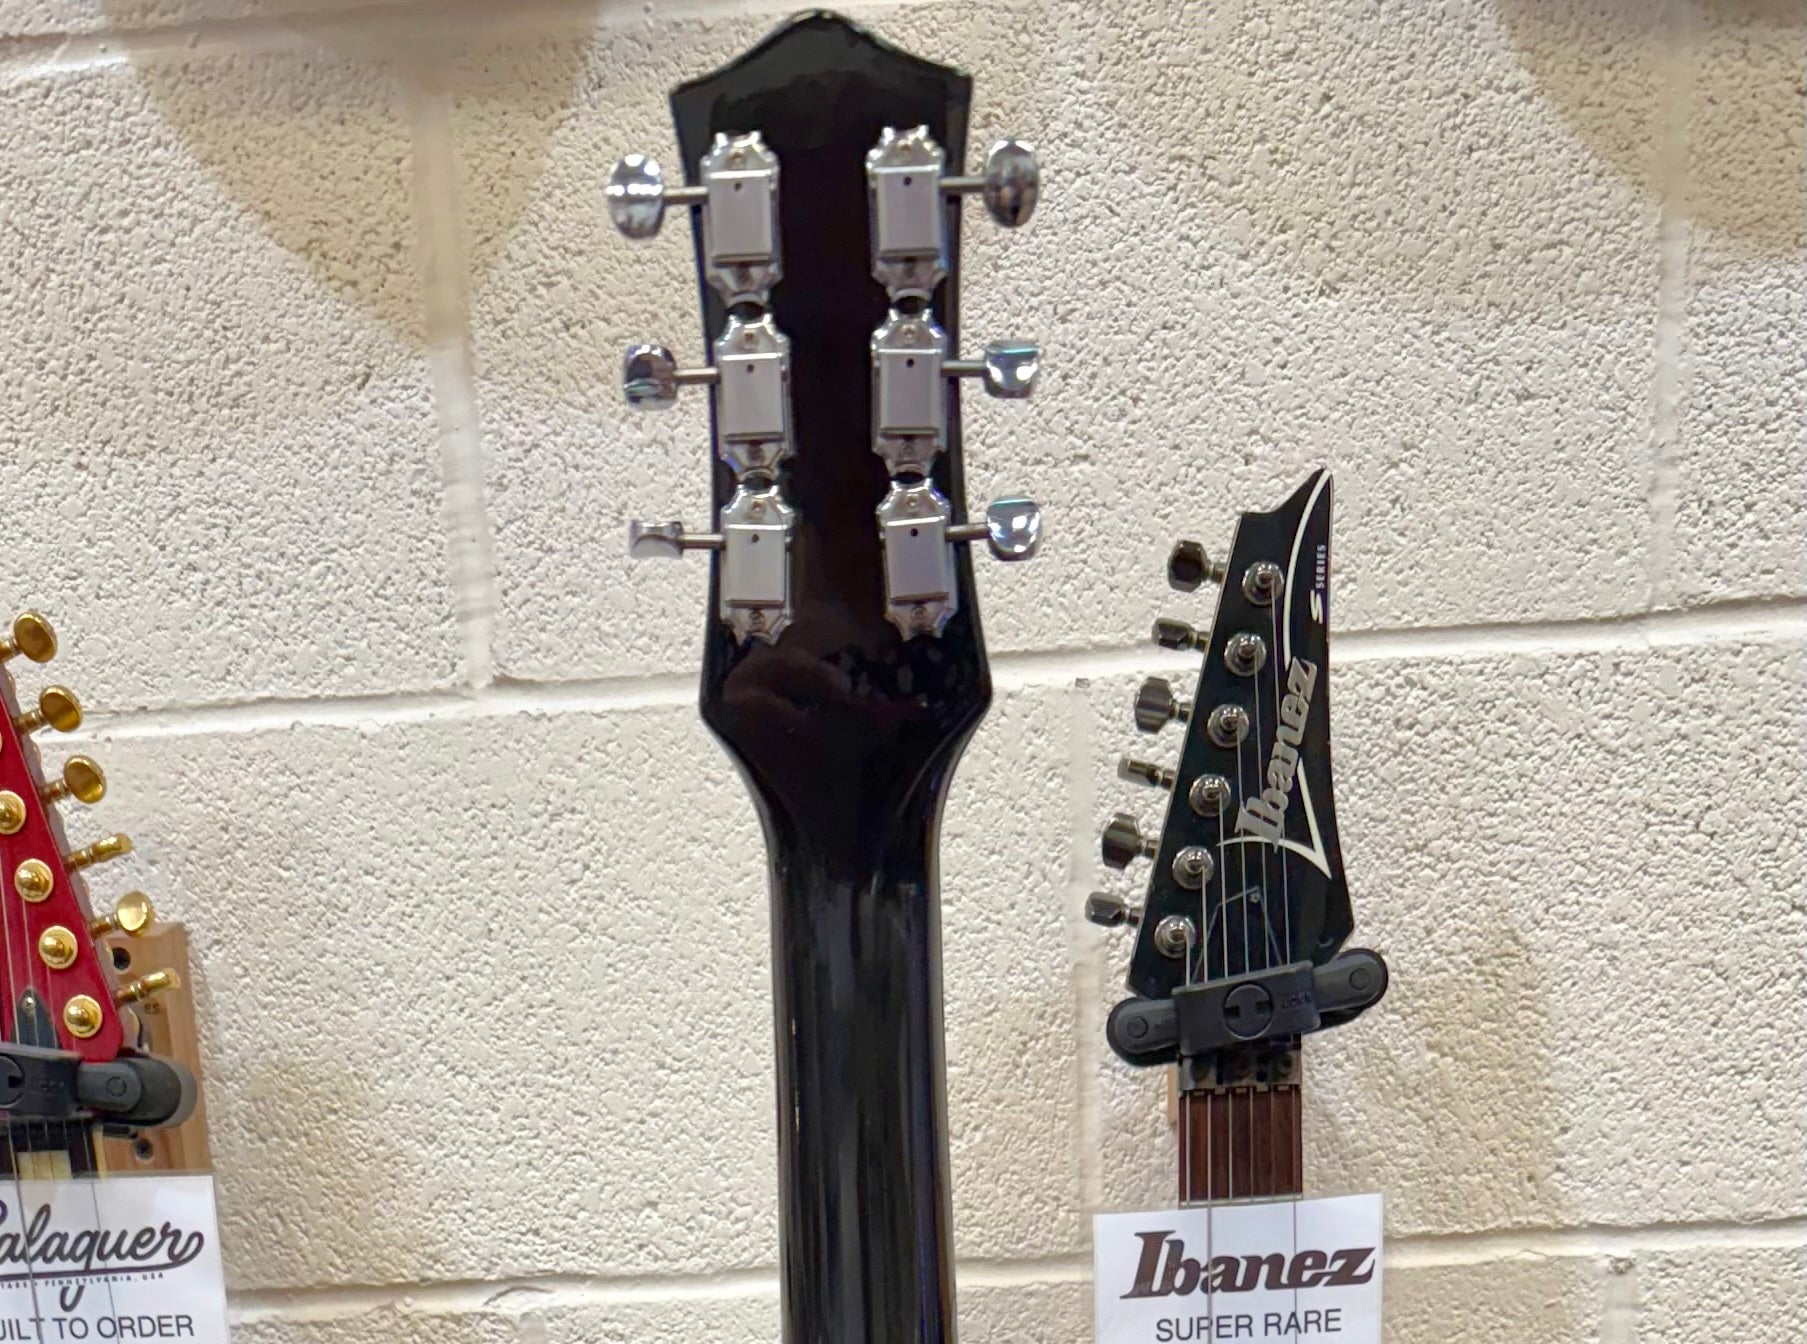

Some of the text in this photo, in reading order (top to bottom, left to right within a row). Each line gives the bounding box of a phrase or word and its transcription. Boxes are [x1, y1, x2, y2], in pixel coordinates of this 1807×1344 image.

[1315, 544, 1326, 589] SERIES
[1234, 656, 1317, 853] Ibanez
[0, 1201, 205, 1312] alaguer
[1120, 1230, 1376, 1299] Ibanez
[52, 1316, 89, 1340] TO
[97, 1315, 195, 1339] ORDER
[1156, 1308, 1342, 1342] SUPER RARE
